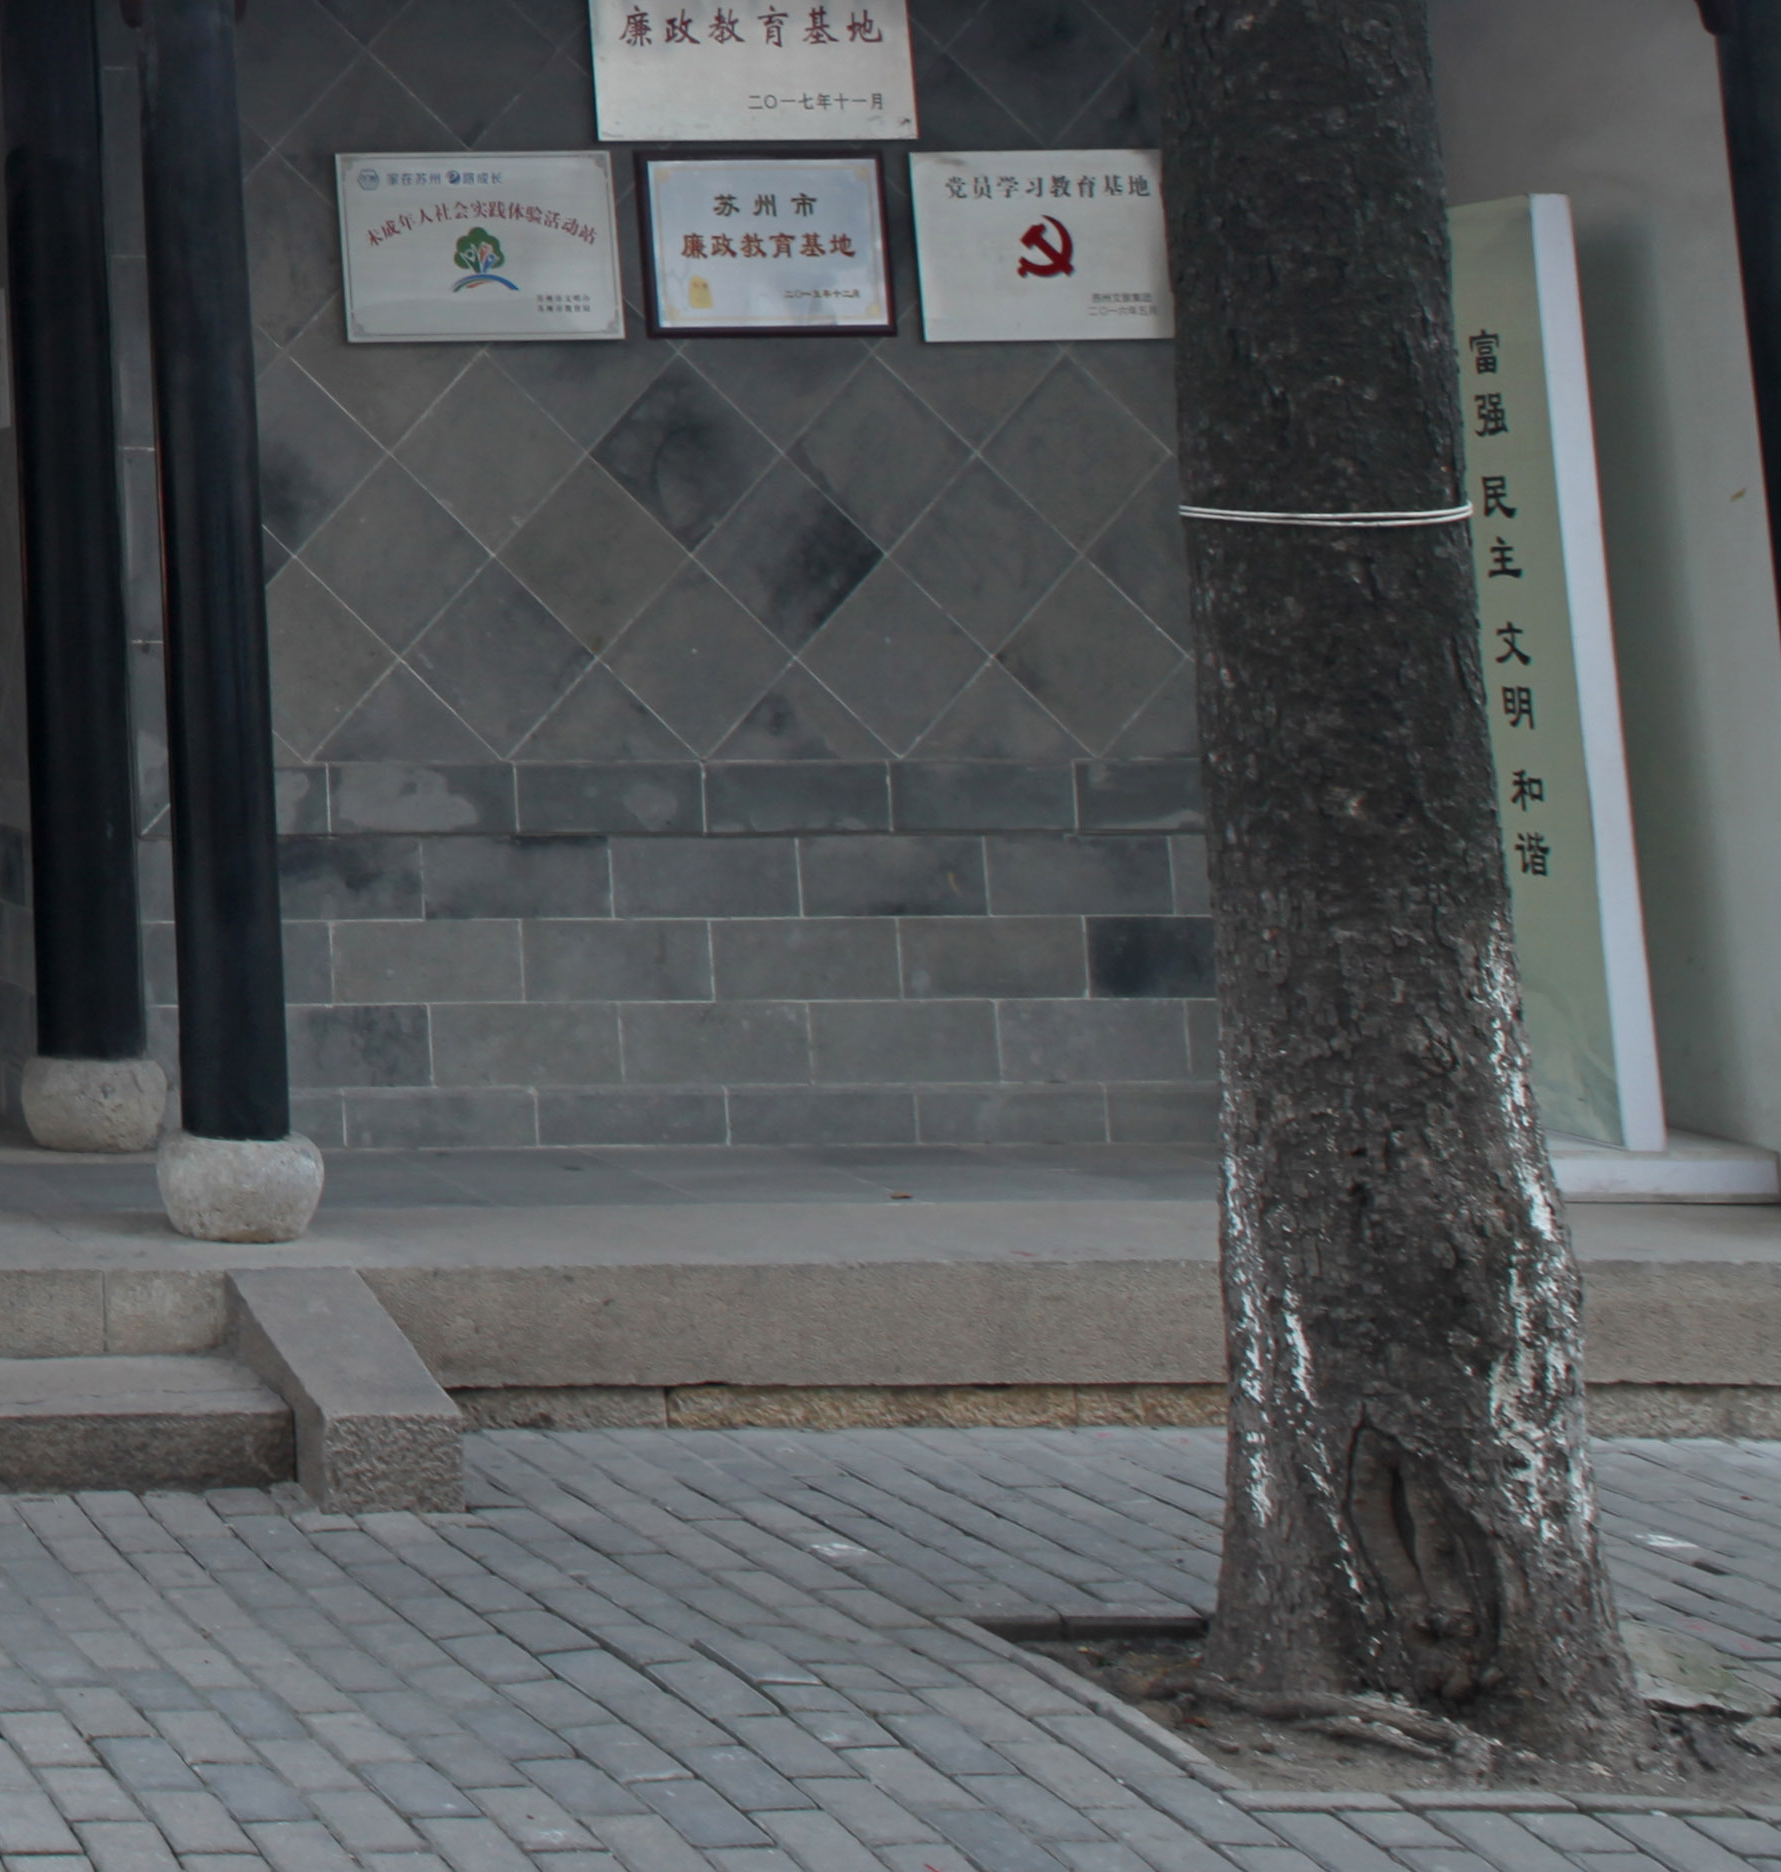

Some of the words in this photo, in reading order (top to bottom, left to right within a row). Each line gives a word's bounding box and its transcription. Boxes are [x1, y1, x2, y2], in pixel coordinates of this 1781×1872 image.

[618, 5, 883, 48] 廉政教育基地
[386, 172, 442, 186] 家在苏州
[945, 174, 1151, 199] 党员学习教育基地
[366, 200, 597, 247] 未成年人社会实践体验活动站
[713, 193, 817, 217] 苏州市
[681, 233, 856, 260] 廉政教育基地
[1468, 328, 1509, 439] 富强
[1481, 474, 1523, 581] 民主
[1495, 619, 1536, 731] 文明
[1510, 768, 1550, 879] 和谐
